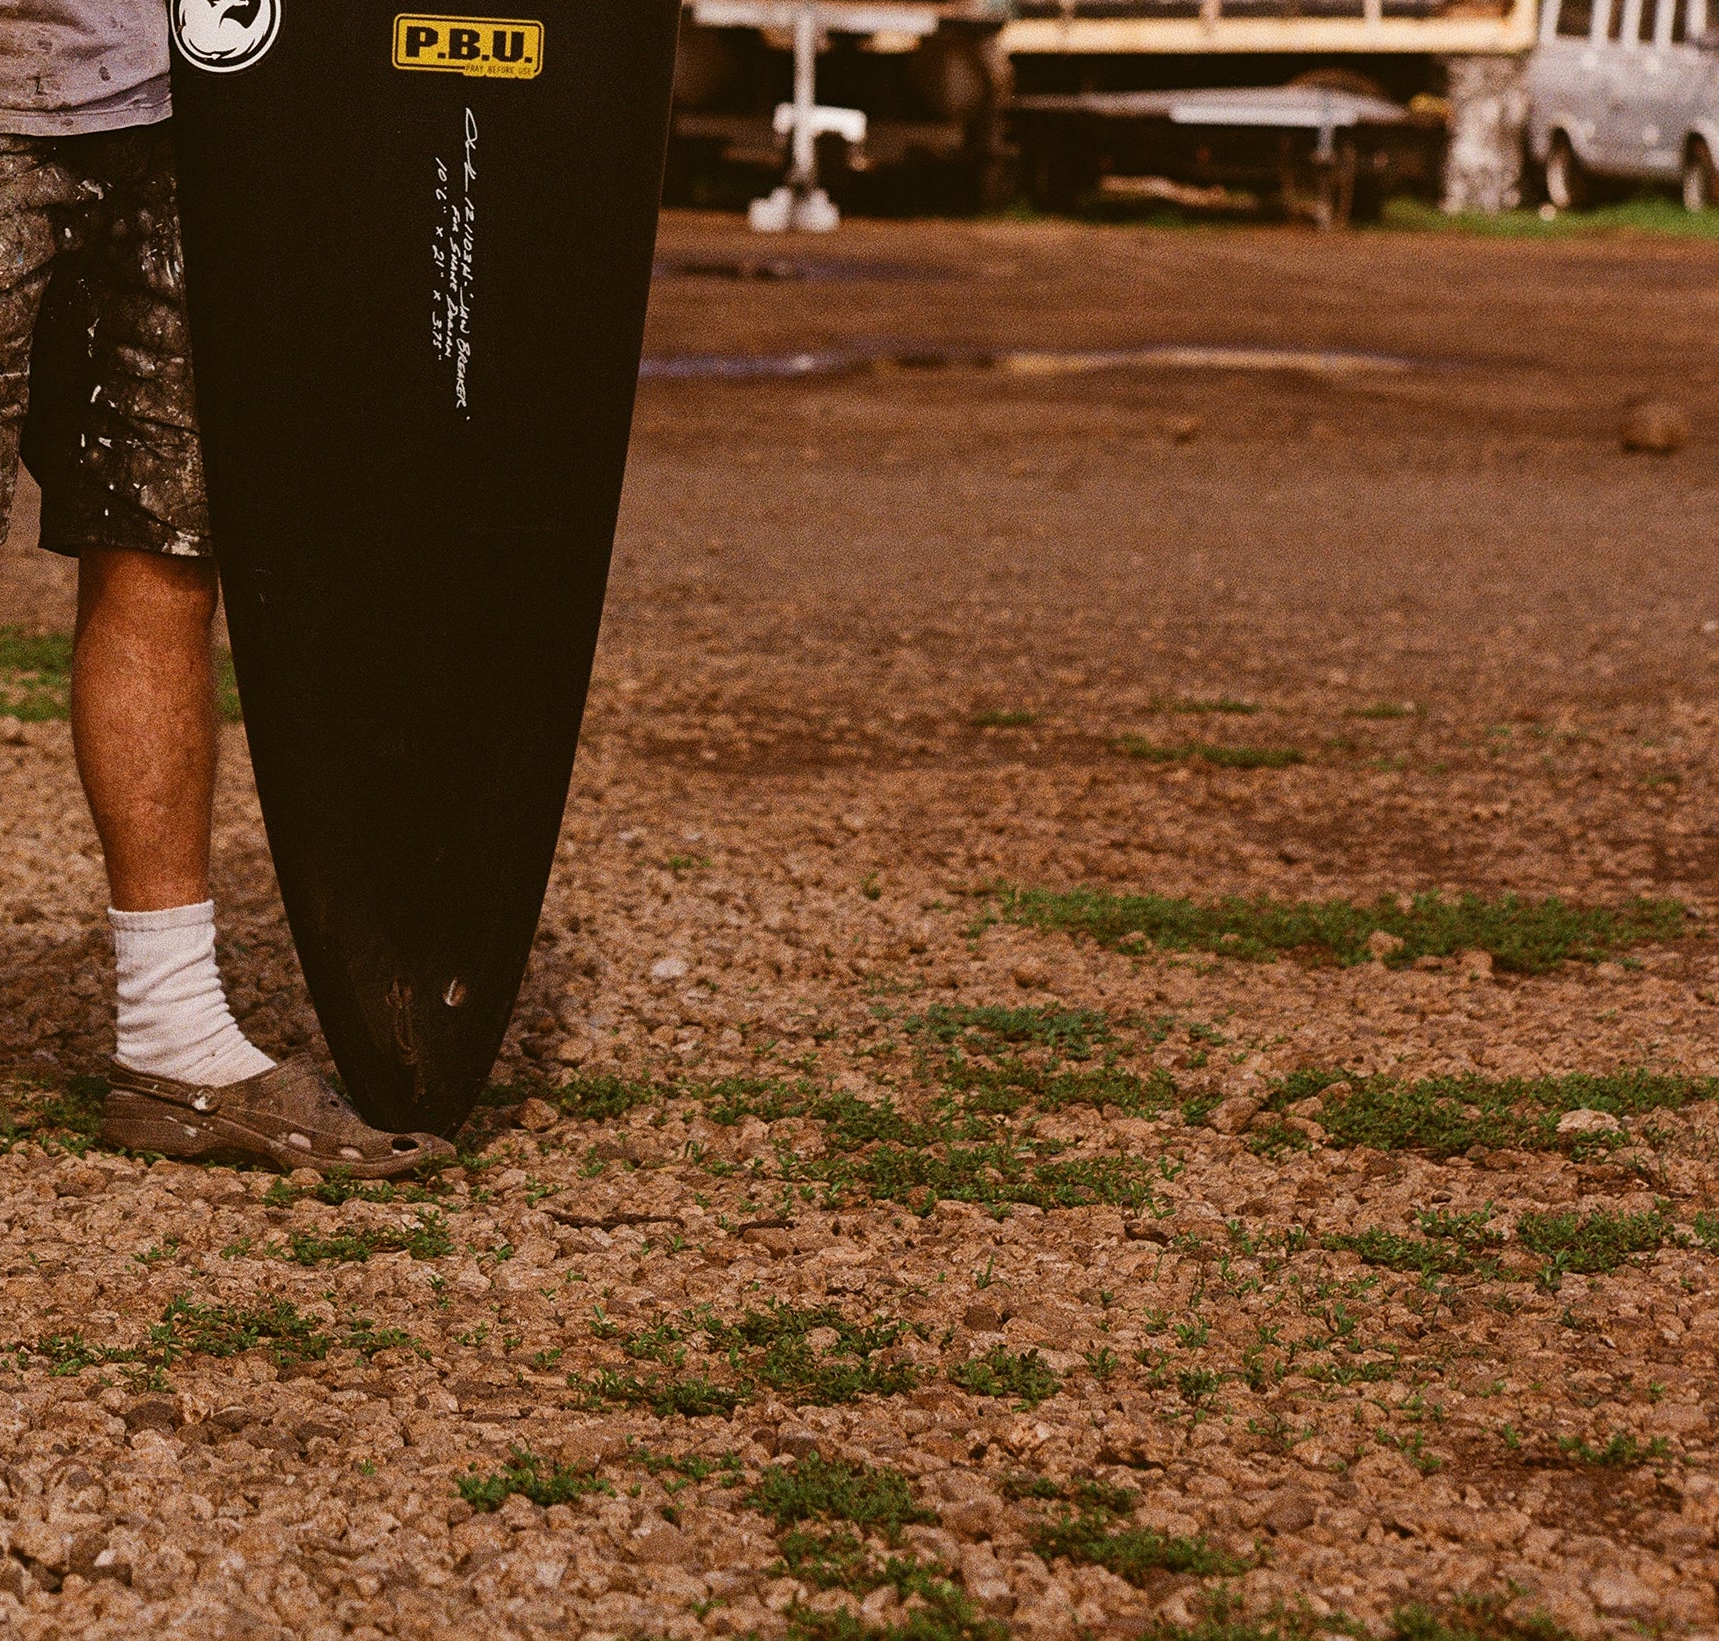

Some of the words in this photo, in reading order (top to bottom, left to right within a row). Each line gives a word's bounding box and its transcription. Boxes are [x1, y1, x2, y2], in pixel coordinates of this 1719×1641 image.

[405, 25, 533, 64] P.B.U.
[465, 63, 484, 74] PRAY
[487, 65, 515, 75] BEFORE
